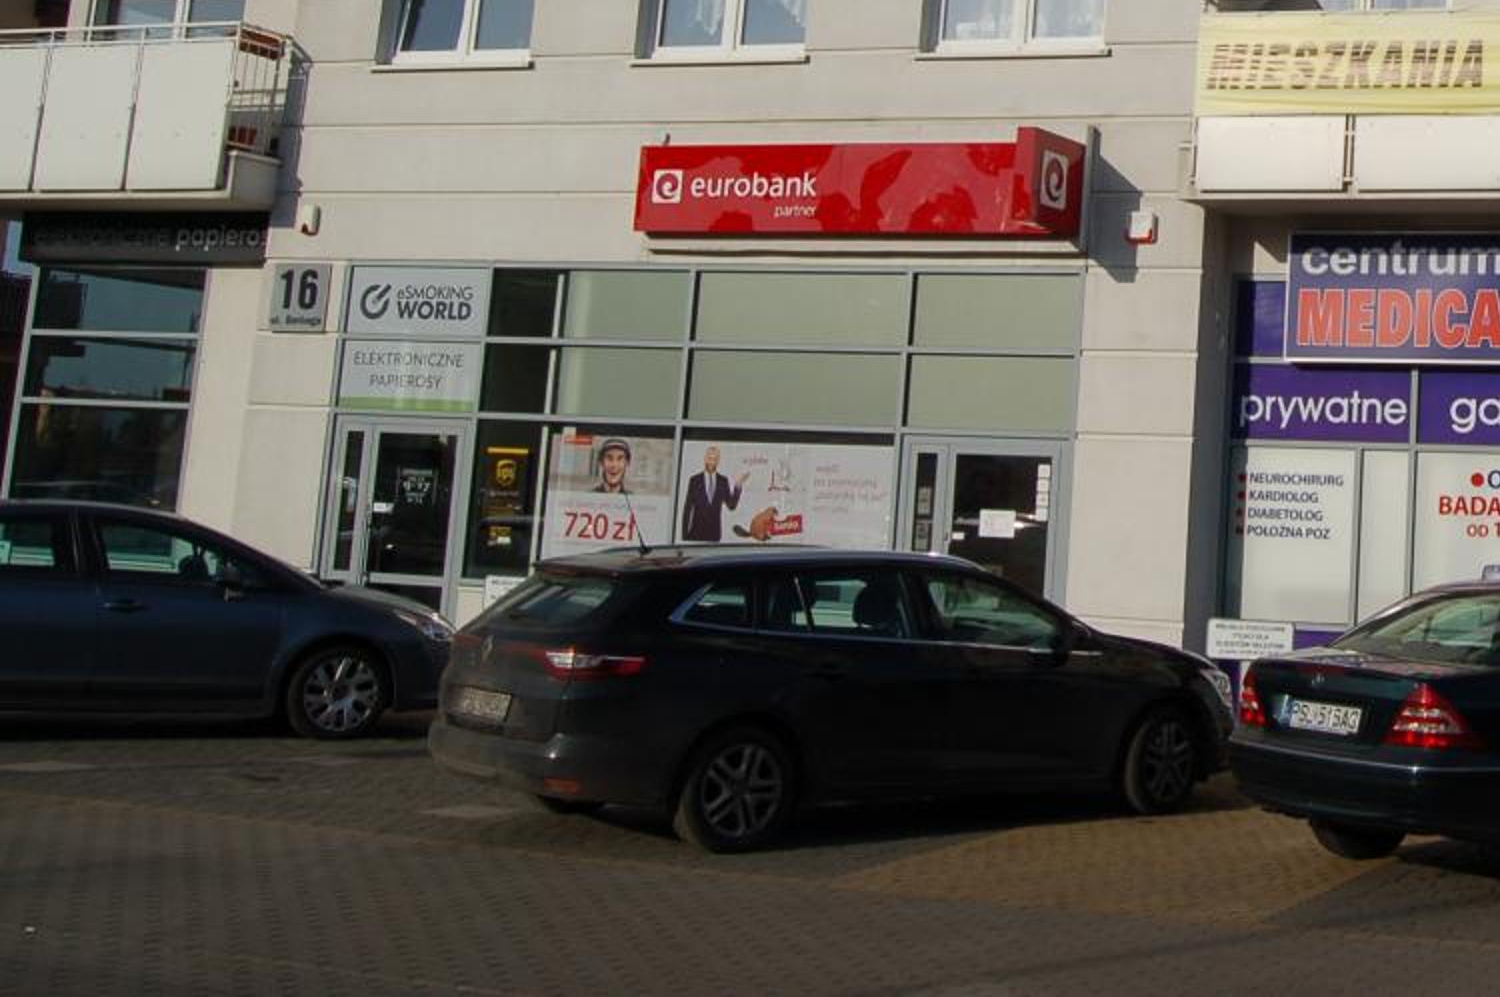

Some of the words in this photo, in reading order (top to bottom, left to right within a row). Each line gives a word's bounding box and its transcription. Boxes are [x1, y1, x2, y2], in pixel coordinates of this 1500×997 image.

[1206, 38, 1484, 91] MIESZKANIA
[690, 172, 817, 197] eurobank
[774, 204, 817, 220] partner
[281, 268, 319, 311] 16
[397, 302, 471, 320] WORLD
[353, 350, 464, 369] ELEKTRONICZNE
[369, 373, 441, 390] PAPIEROSY
[1242, 390, 1408, 428] prywatne
[1249, 472, 1344, 487] NEUROCHIRURG
[1248, 491, 1319, 503] KARDIOLOG
[1247, 507, 1323, 522] DIABETOLOG
[564, 512, 609, 540] 720
[1467, 524, 1488, 537] OD
